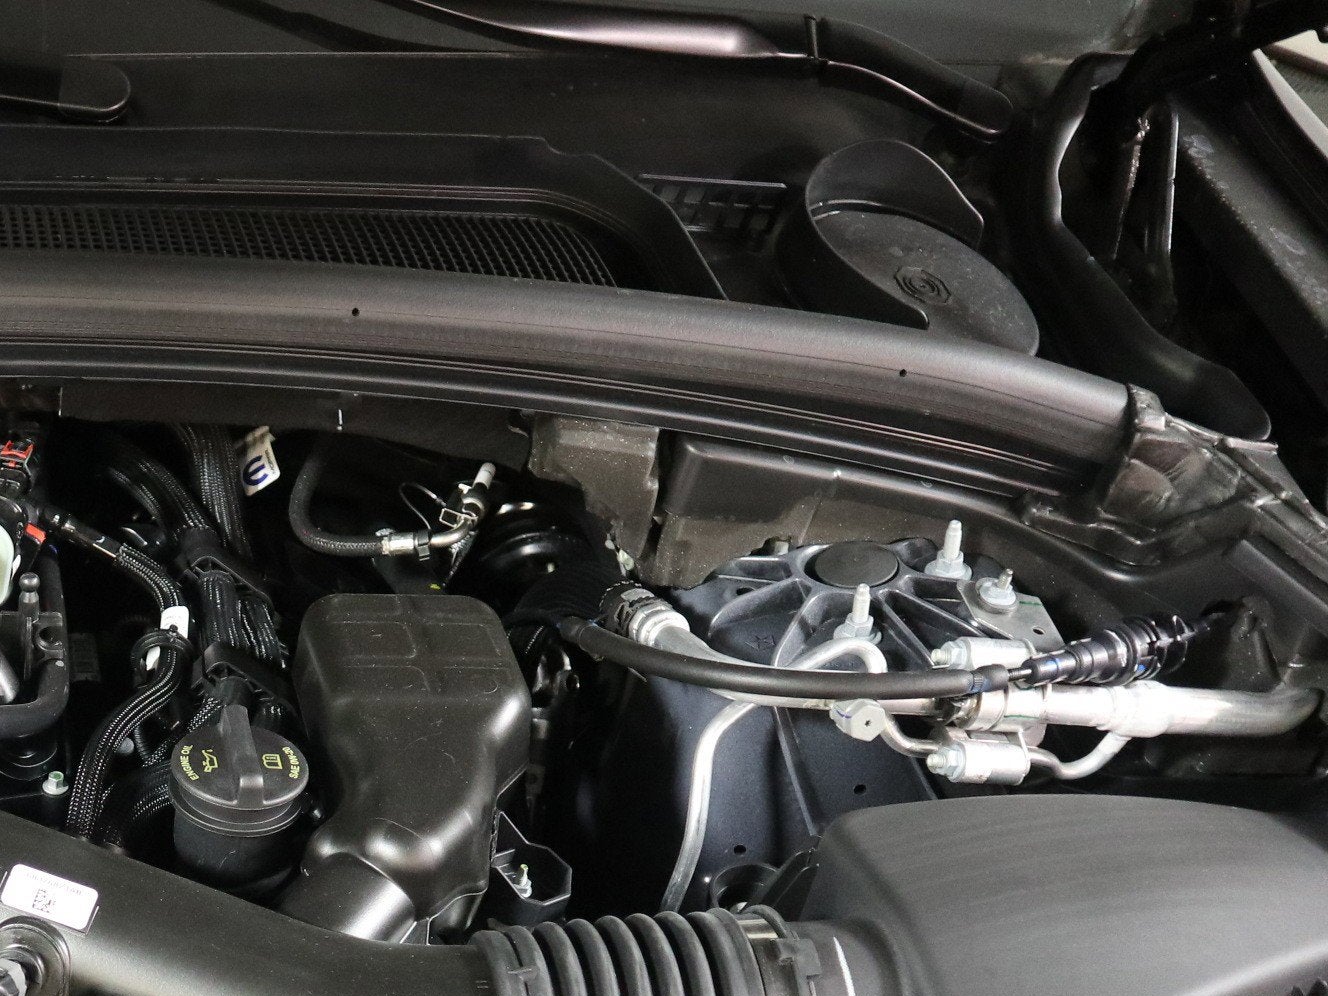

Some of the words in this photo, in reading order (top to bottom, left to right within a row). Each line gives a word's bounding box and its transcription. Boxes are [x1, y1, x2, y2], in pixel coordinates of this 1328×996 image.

[180, 744, 193, 755] OIL
[179, 755, 199, 781] ENGINE
[288, 765, 300, 779] SAE
